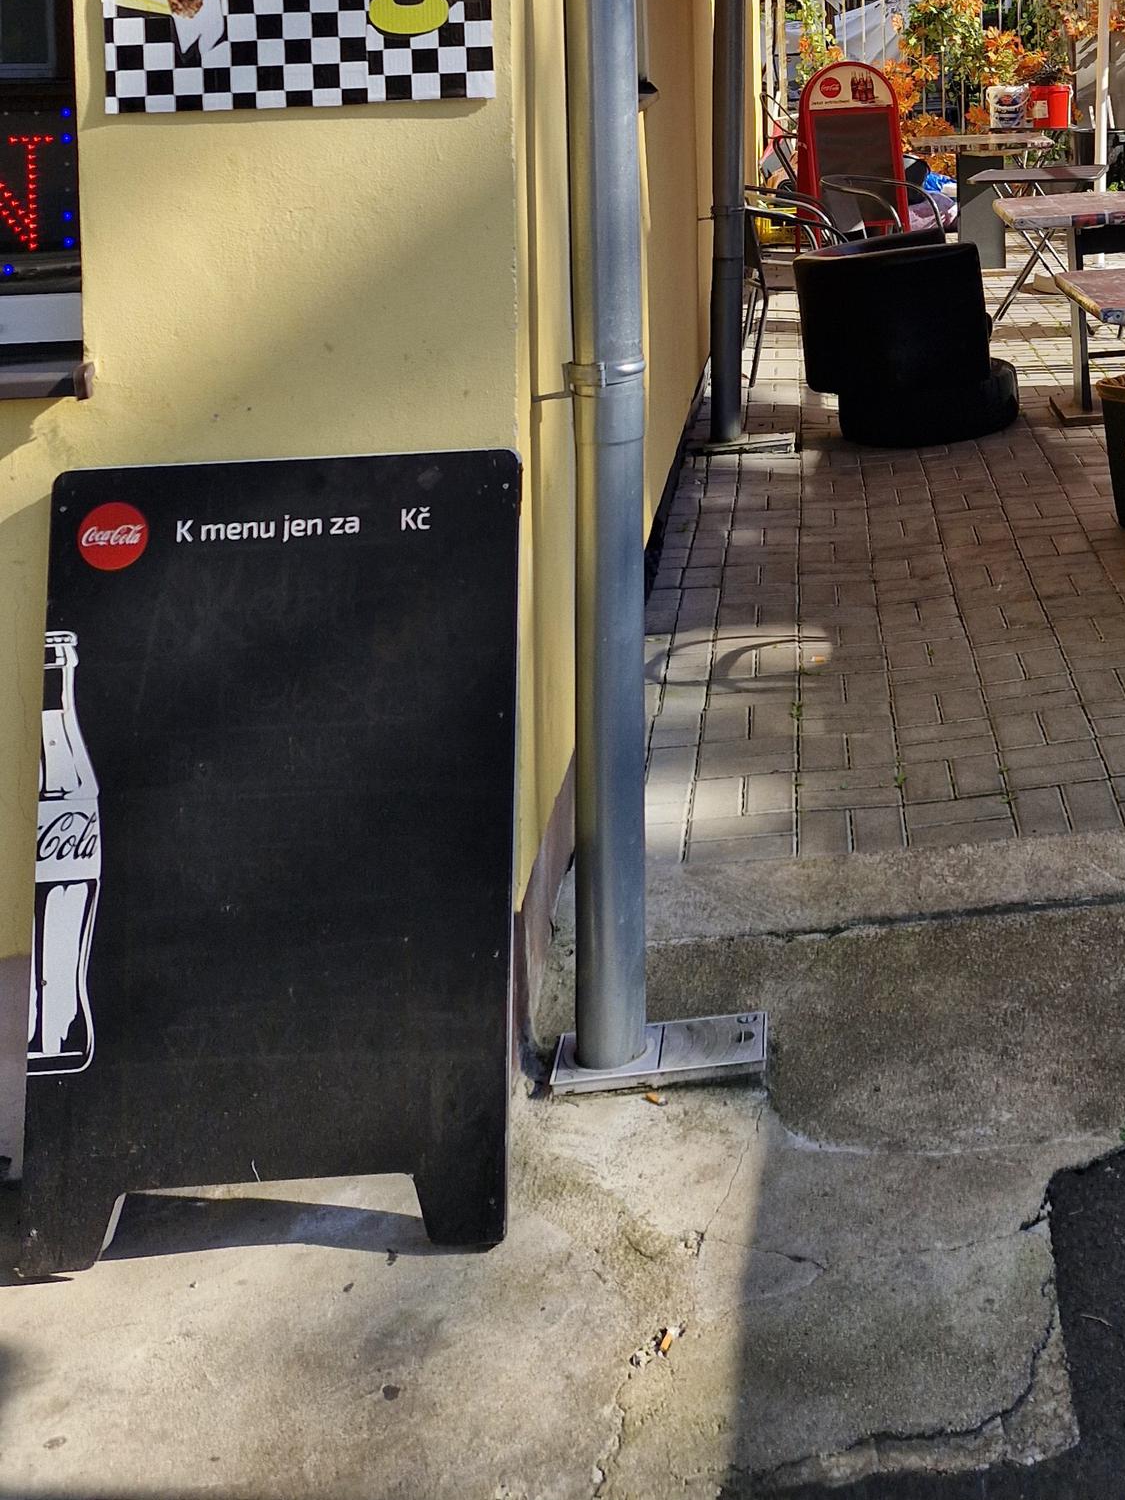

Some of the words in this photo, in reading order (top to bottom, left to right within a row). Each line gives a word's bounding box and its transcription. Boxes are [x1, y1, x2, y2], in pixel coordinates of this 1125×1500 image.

[175, 519, 194, 543] K
[200, 512, 276, 542] menu
[281, 514, 323, 543] jen
[328, 514, 361, 535] za
[400, 506, 432, 532] Kč
